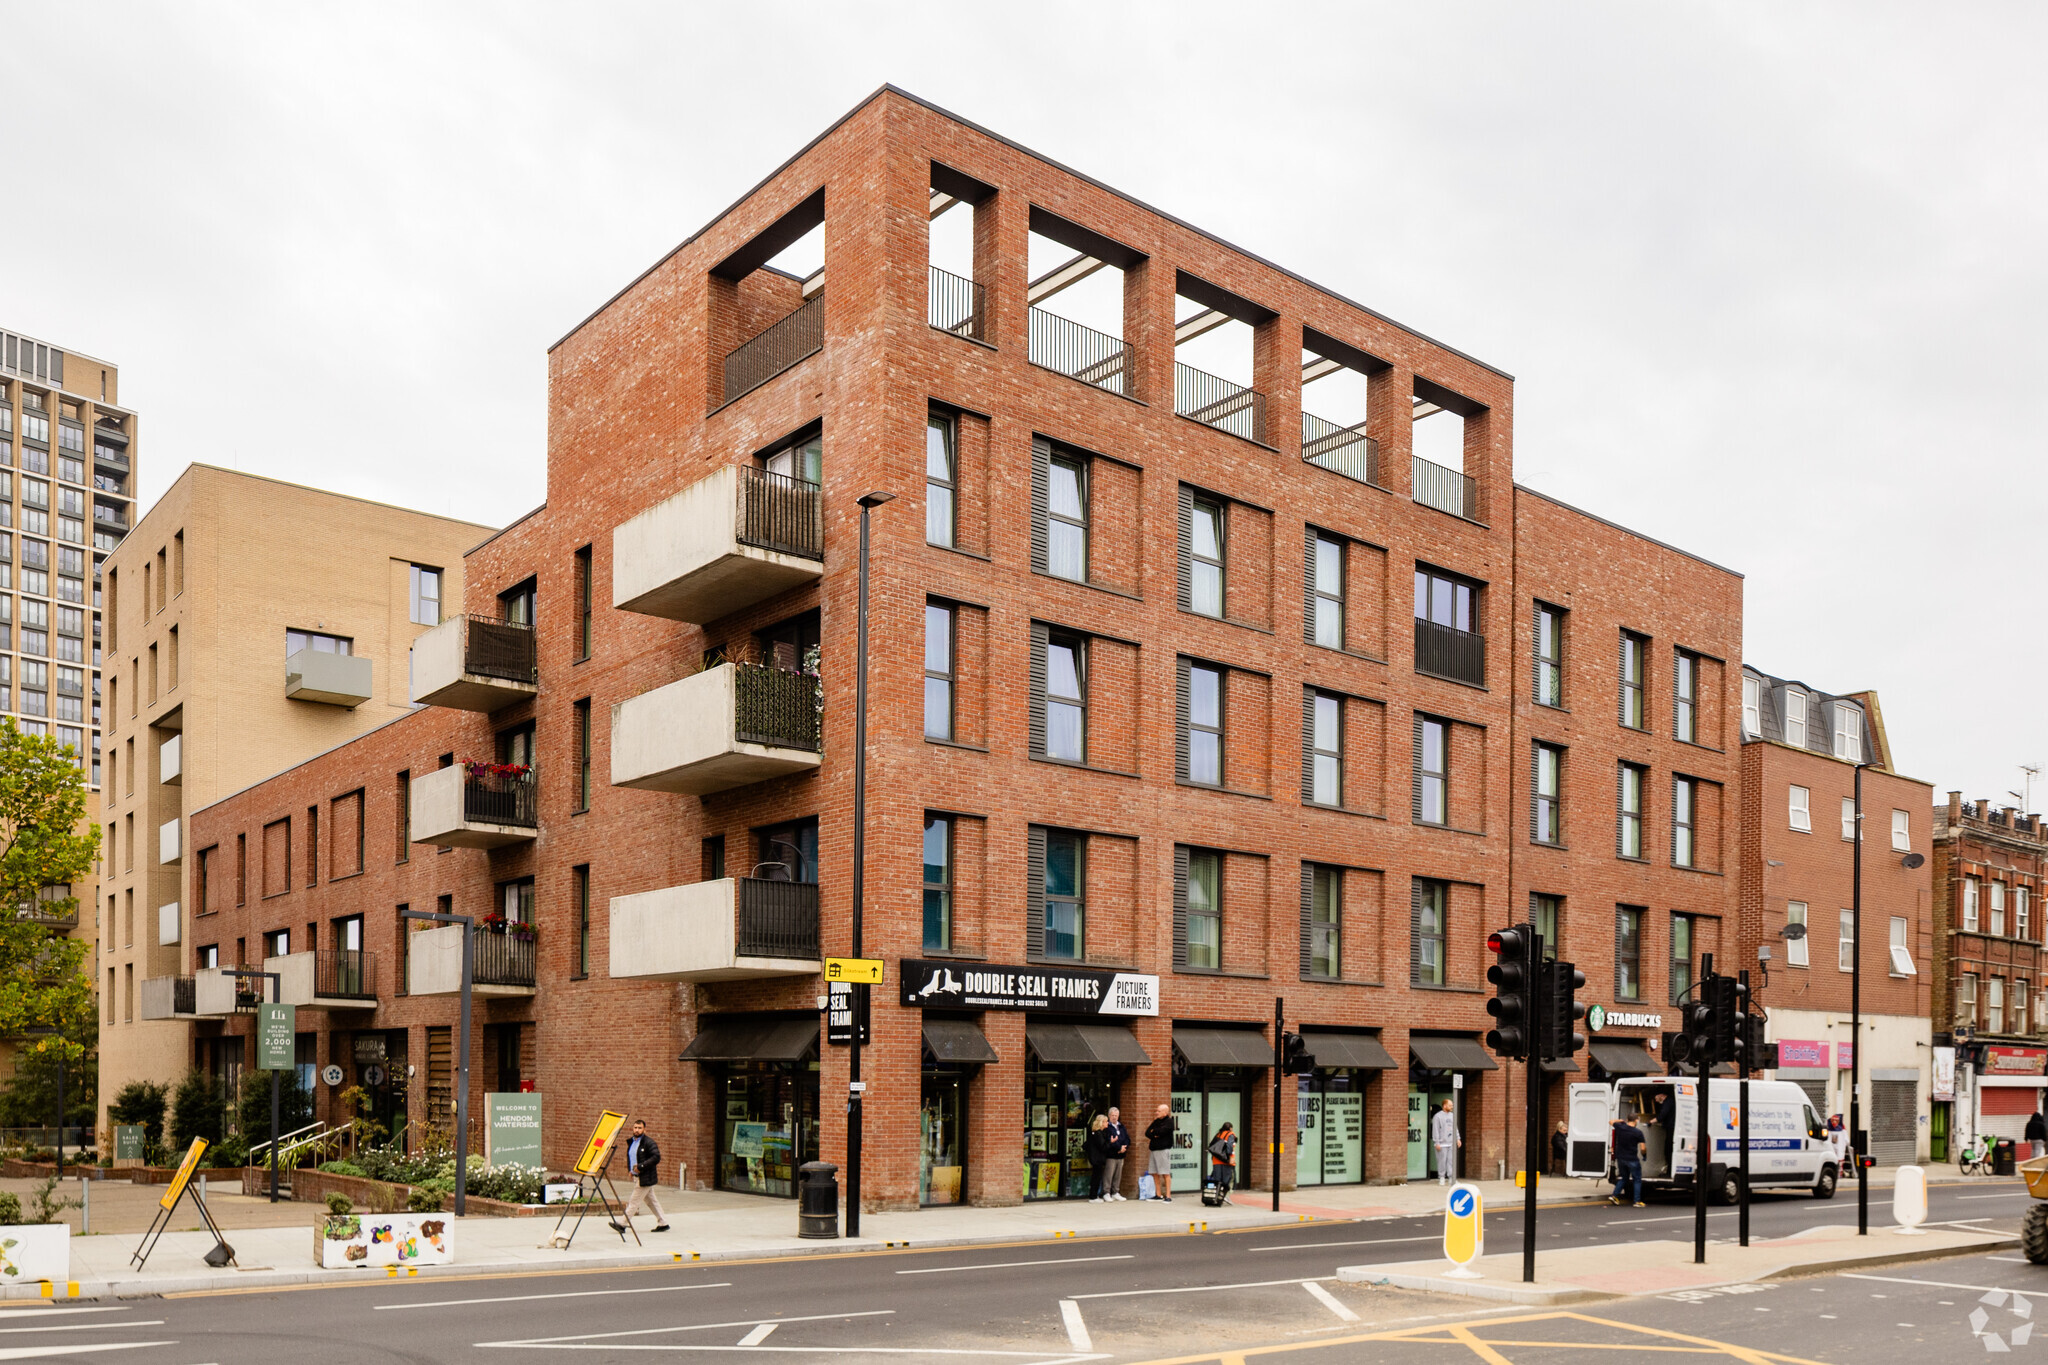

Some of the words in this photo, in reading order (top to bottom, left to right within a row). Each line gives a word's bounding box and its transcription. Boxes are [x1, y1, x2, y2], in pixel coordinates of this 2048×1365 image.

[830, 981, 852, 994] DOUBL
[965, 972, 1015, 994] DOUBLE
[1018, 975, 1048, 996] SEAL
[1052, 977, 1099, 999] FRAMES
[1116, 981, 1148, 995] PICTURE
[830, 995, 847, 1010] SEAL
[1116, 996, 1151, 1010] FRAMERS
[830, 1011, 852, 1026] FRAM
[1606, 1012, 1661, 1027] STARBUCKS
[355, 1040, 378, 1051] SAKURA
[1171, 1098, 1191, 1113] UBLE
[1297, 1097, 1320, 1112] TURES
[1408, 1097, 1420, 1111] BLE
[1298, 1114, 1315, 1128] MED
[1748, 1110, 1775, 1118] holesalers
